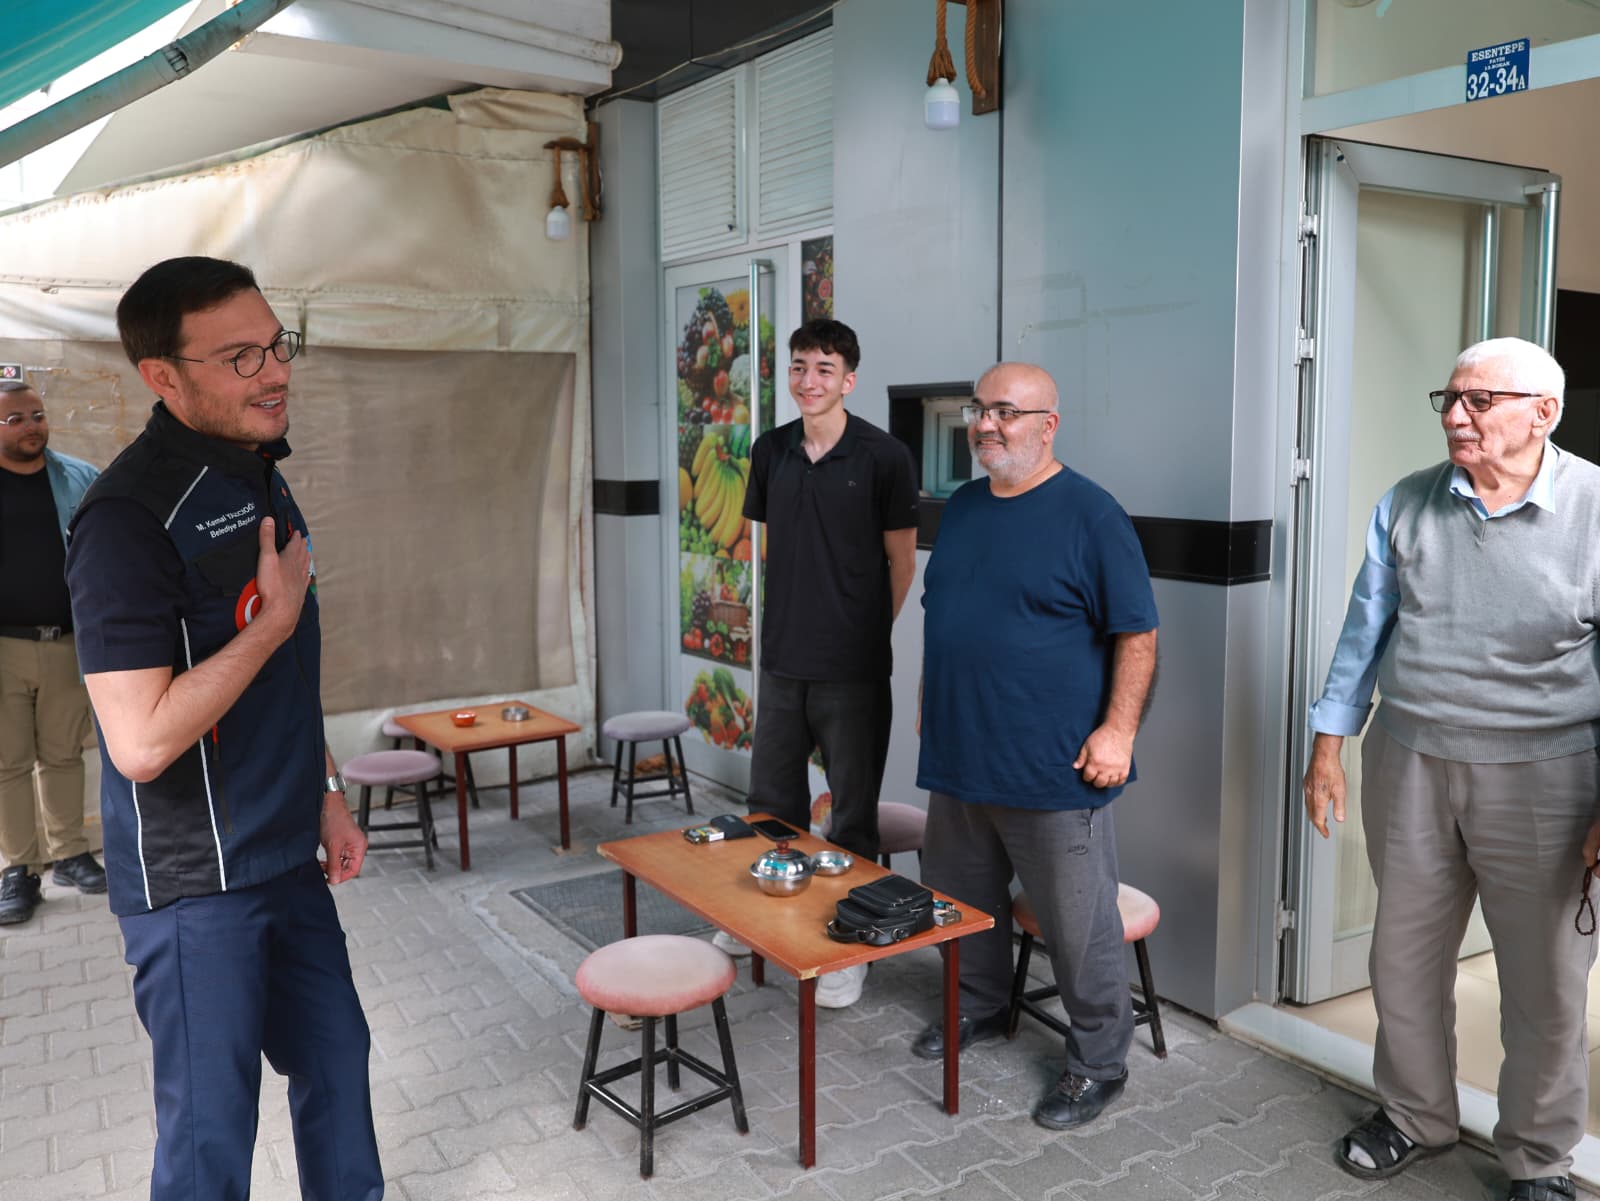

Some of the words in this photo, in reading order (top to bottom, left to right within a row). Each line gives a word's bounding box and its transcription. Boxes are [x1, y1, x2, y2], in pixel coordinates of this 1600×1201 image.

[1471, 42, 1525, 62] ESENTEPE
[195, 523, 207, 531] M.
[210, 524, 237, 538] Belediye
